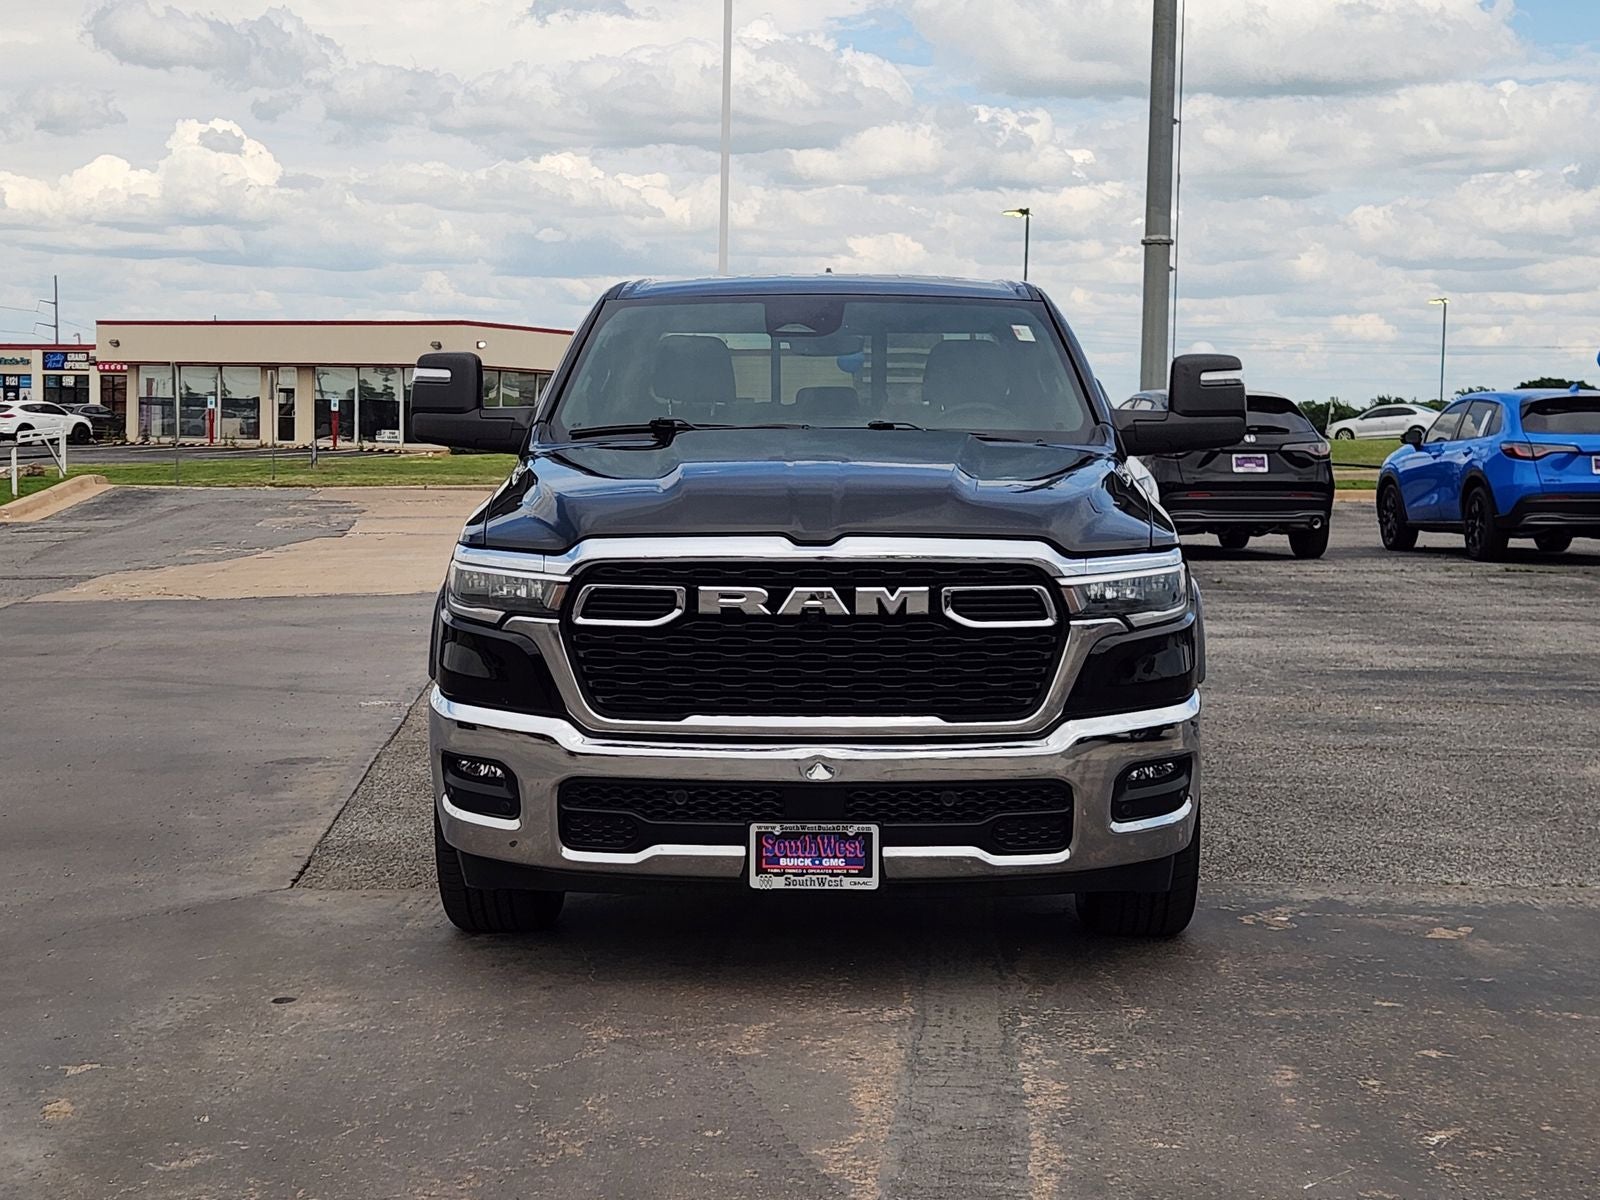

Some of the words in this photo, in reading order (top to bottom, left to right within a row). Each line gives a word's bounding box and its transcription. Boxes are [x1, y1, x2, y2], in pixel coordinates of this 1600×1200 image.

[698, 586, 930, 615] RAM
[756, 824, 872, 832] wwwSouthWestBuickGMC.com
[762, 833, 865, 858] SouthWest
[780, 857, 812, 867] BUICK
[822, 858, 846, 867] GMC
[784, 876, 844, 887] SouthWest
